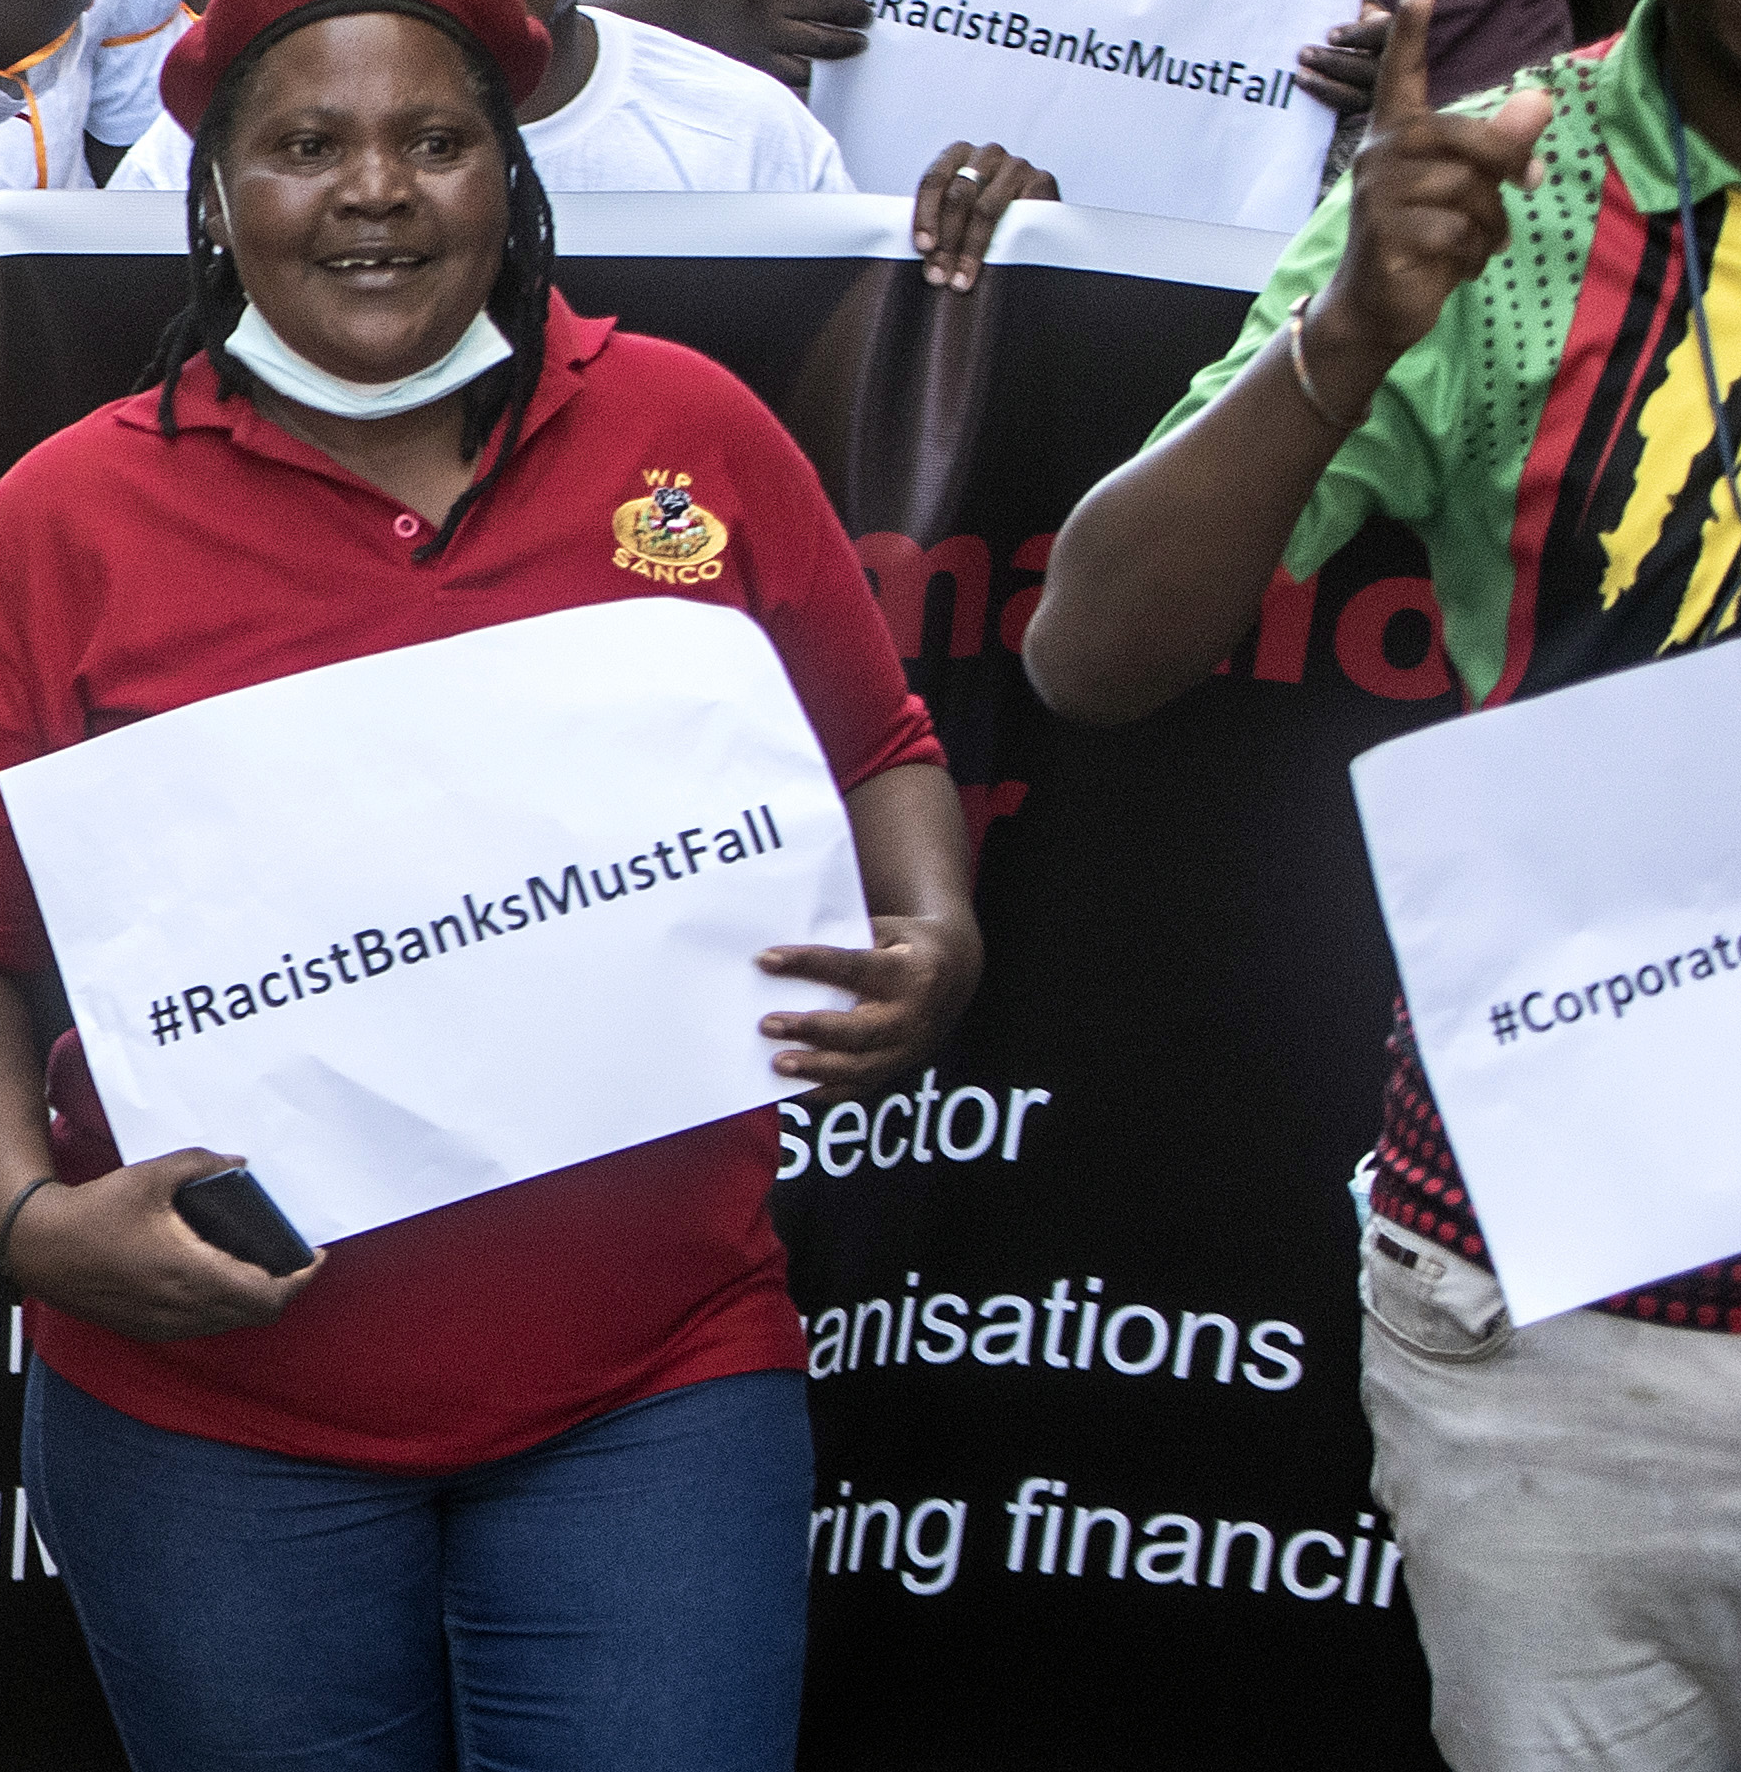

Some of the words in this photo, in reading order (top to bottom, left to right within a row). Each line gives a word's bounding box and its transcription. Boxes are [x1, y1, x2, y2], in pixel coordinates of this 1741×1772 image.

[611, 546, 725, 586] SANCO
[148, 803, 784, 1047] #RacistBanksMustFall
[1488, 932, 1741, 1047] #Corporat
[777, 1065, 1054, 1181] sector
[799, 1270, 1307, 1392] anisations
[809, 1480, 969, 1597] ring
[1006, 1476, 1407, 1610] financi
